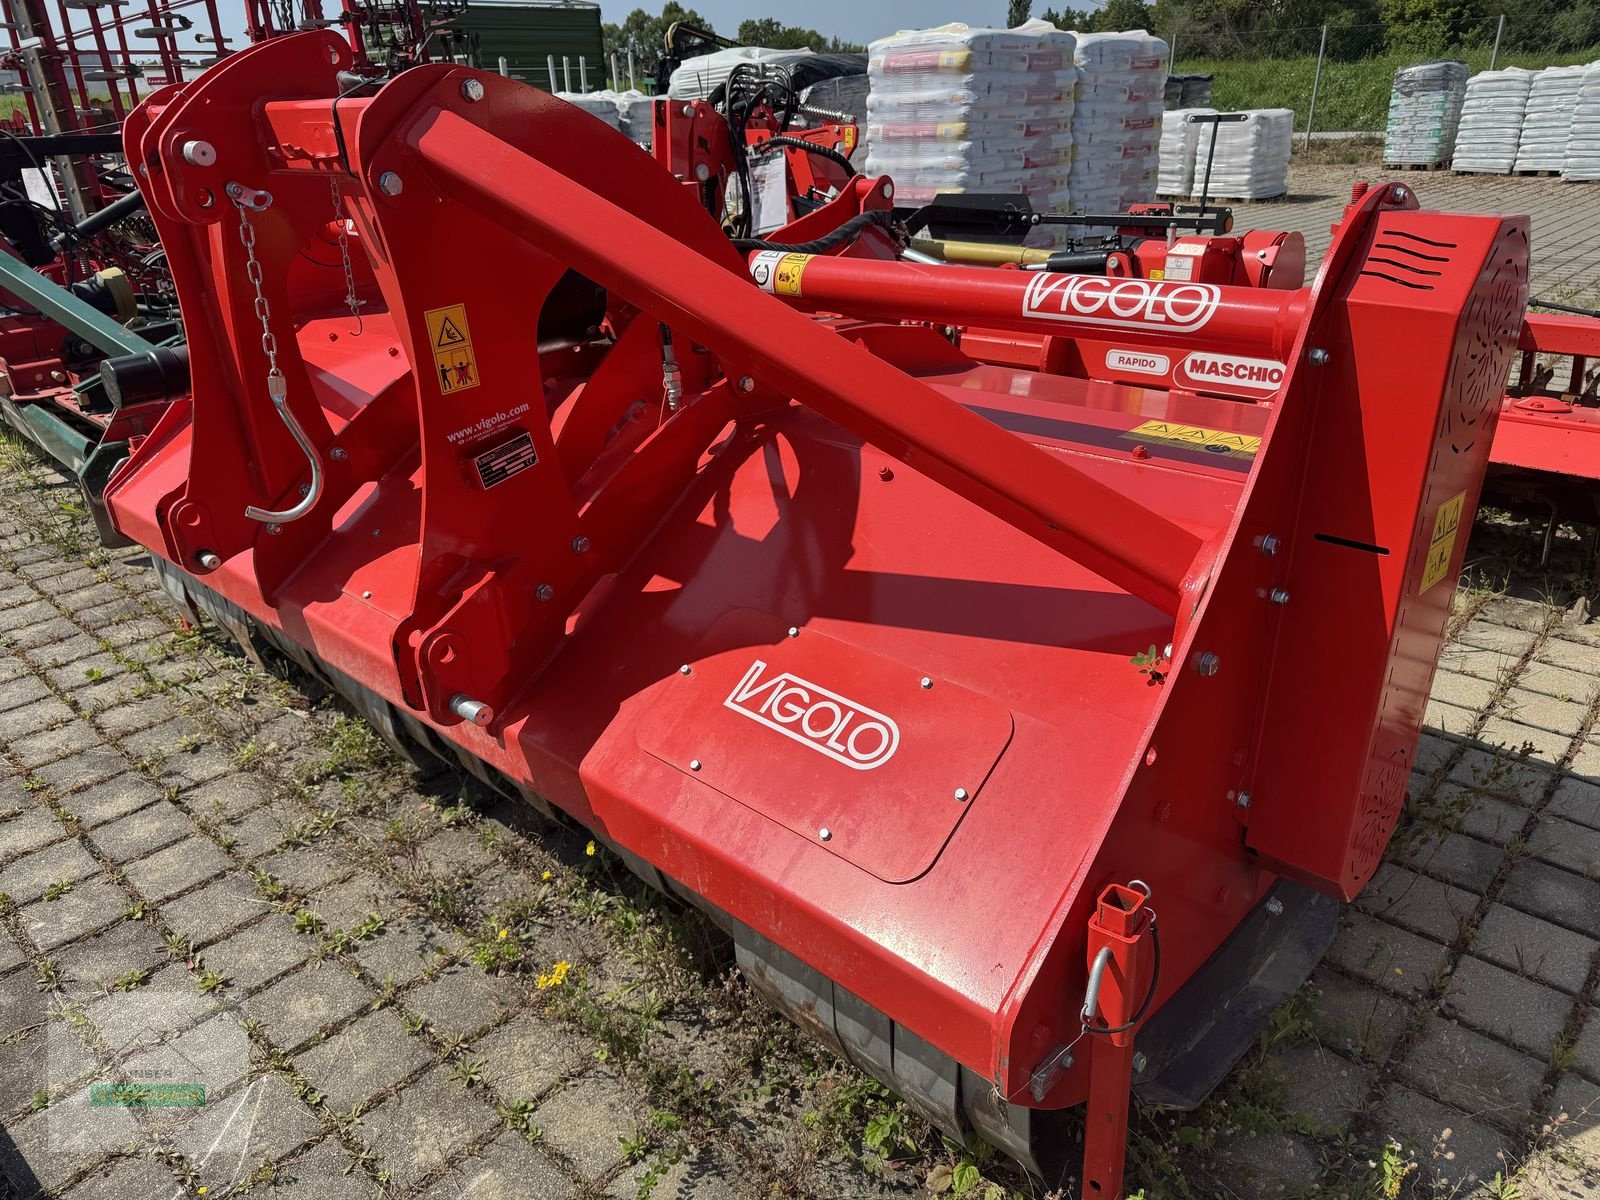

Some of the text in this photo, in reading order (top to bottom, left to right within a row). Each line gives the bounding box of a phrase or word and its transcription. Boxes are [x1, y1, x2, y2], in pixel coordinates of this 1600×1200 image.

[1026, 271, 1212, 324] VIGOLO
[1118, 355, 1156, 369] RAPIDO
[1188, 358, 1284, 384] MASCHIO
[447, 402, 530, 443] www.vigolo.com
[731, 659, 892, 763] VIGOLO
